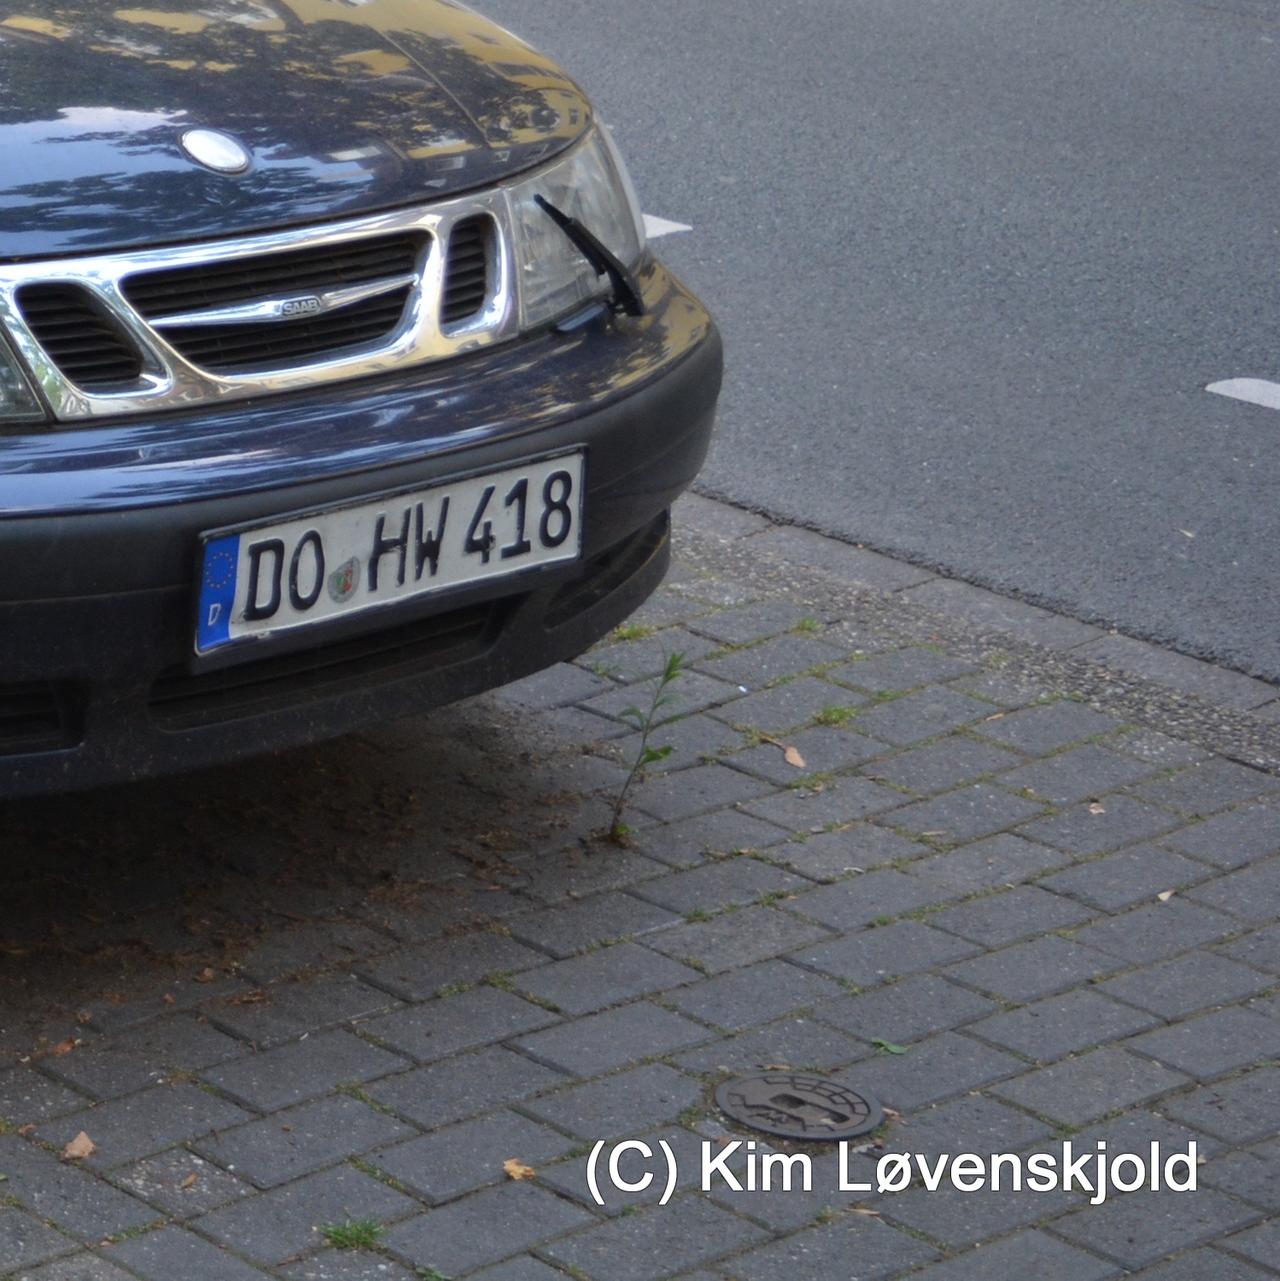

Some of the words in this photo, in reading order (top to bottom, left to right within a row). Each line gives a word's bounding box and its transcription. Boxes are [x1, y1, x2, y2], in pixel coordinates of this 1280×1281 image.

[283, 299, 318, 315] SAAB
[243, 529, 325, 621] DO
[367, 496, 450, 592] HW
[464, 470, 572, 565] 418
[207, 603, 222, 626] D
